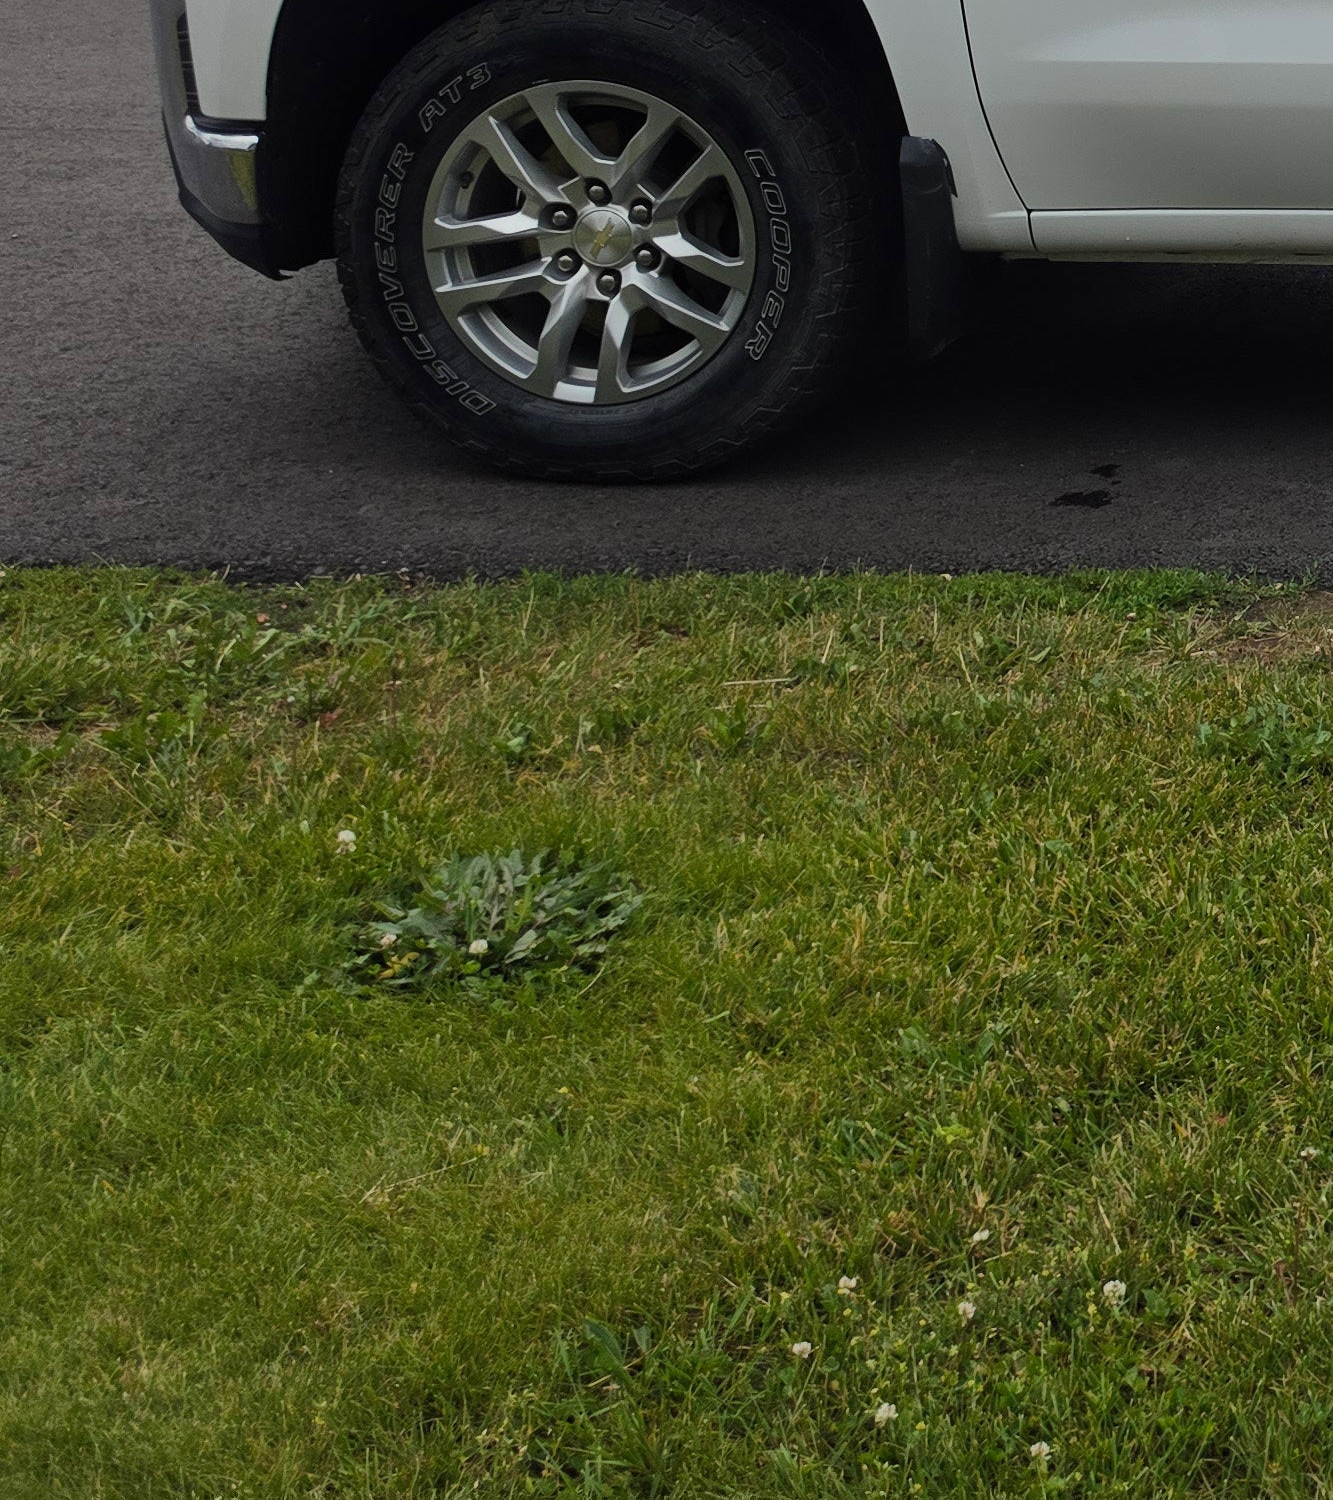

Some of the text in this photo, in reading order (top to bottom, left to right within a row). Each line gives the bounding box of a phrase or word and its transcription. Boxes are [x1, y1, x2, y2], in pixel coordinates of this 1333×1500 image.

[374, 62, 497, 417] DISCOVERER AT3
[744, 149, 791, 361] COOPER
